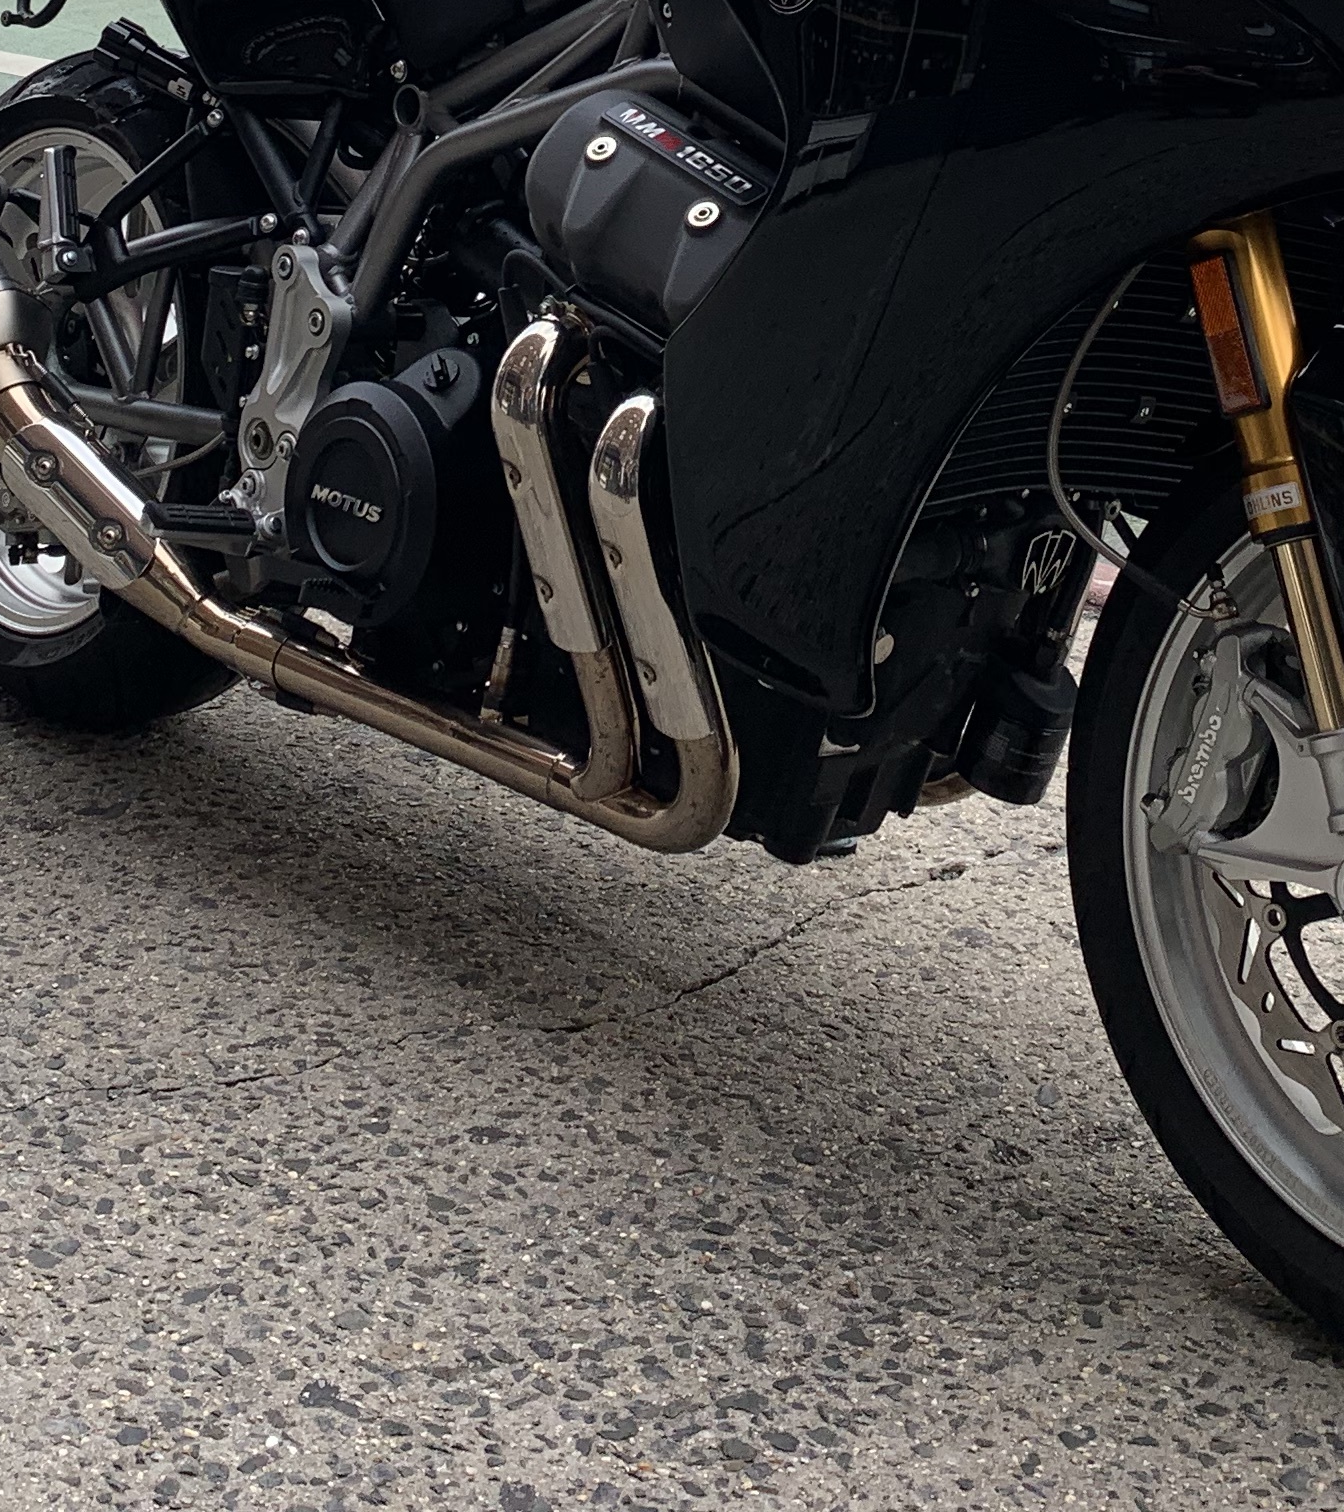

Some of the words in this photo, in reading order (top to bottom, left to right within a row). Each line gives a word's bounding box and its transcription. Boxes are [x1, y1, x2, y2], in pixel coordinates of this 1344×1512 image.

[676, 145, 752, 194] 1650
[310, 484, 382, 522] MOTUS
[1178, 714, 1222, 804] brembo
